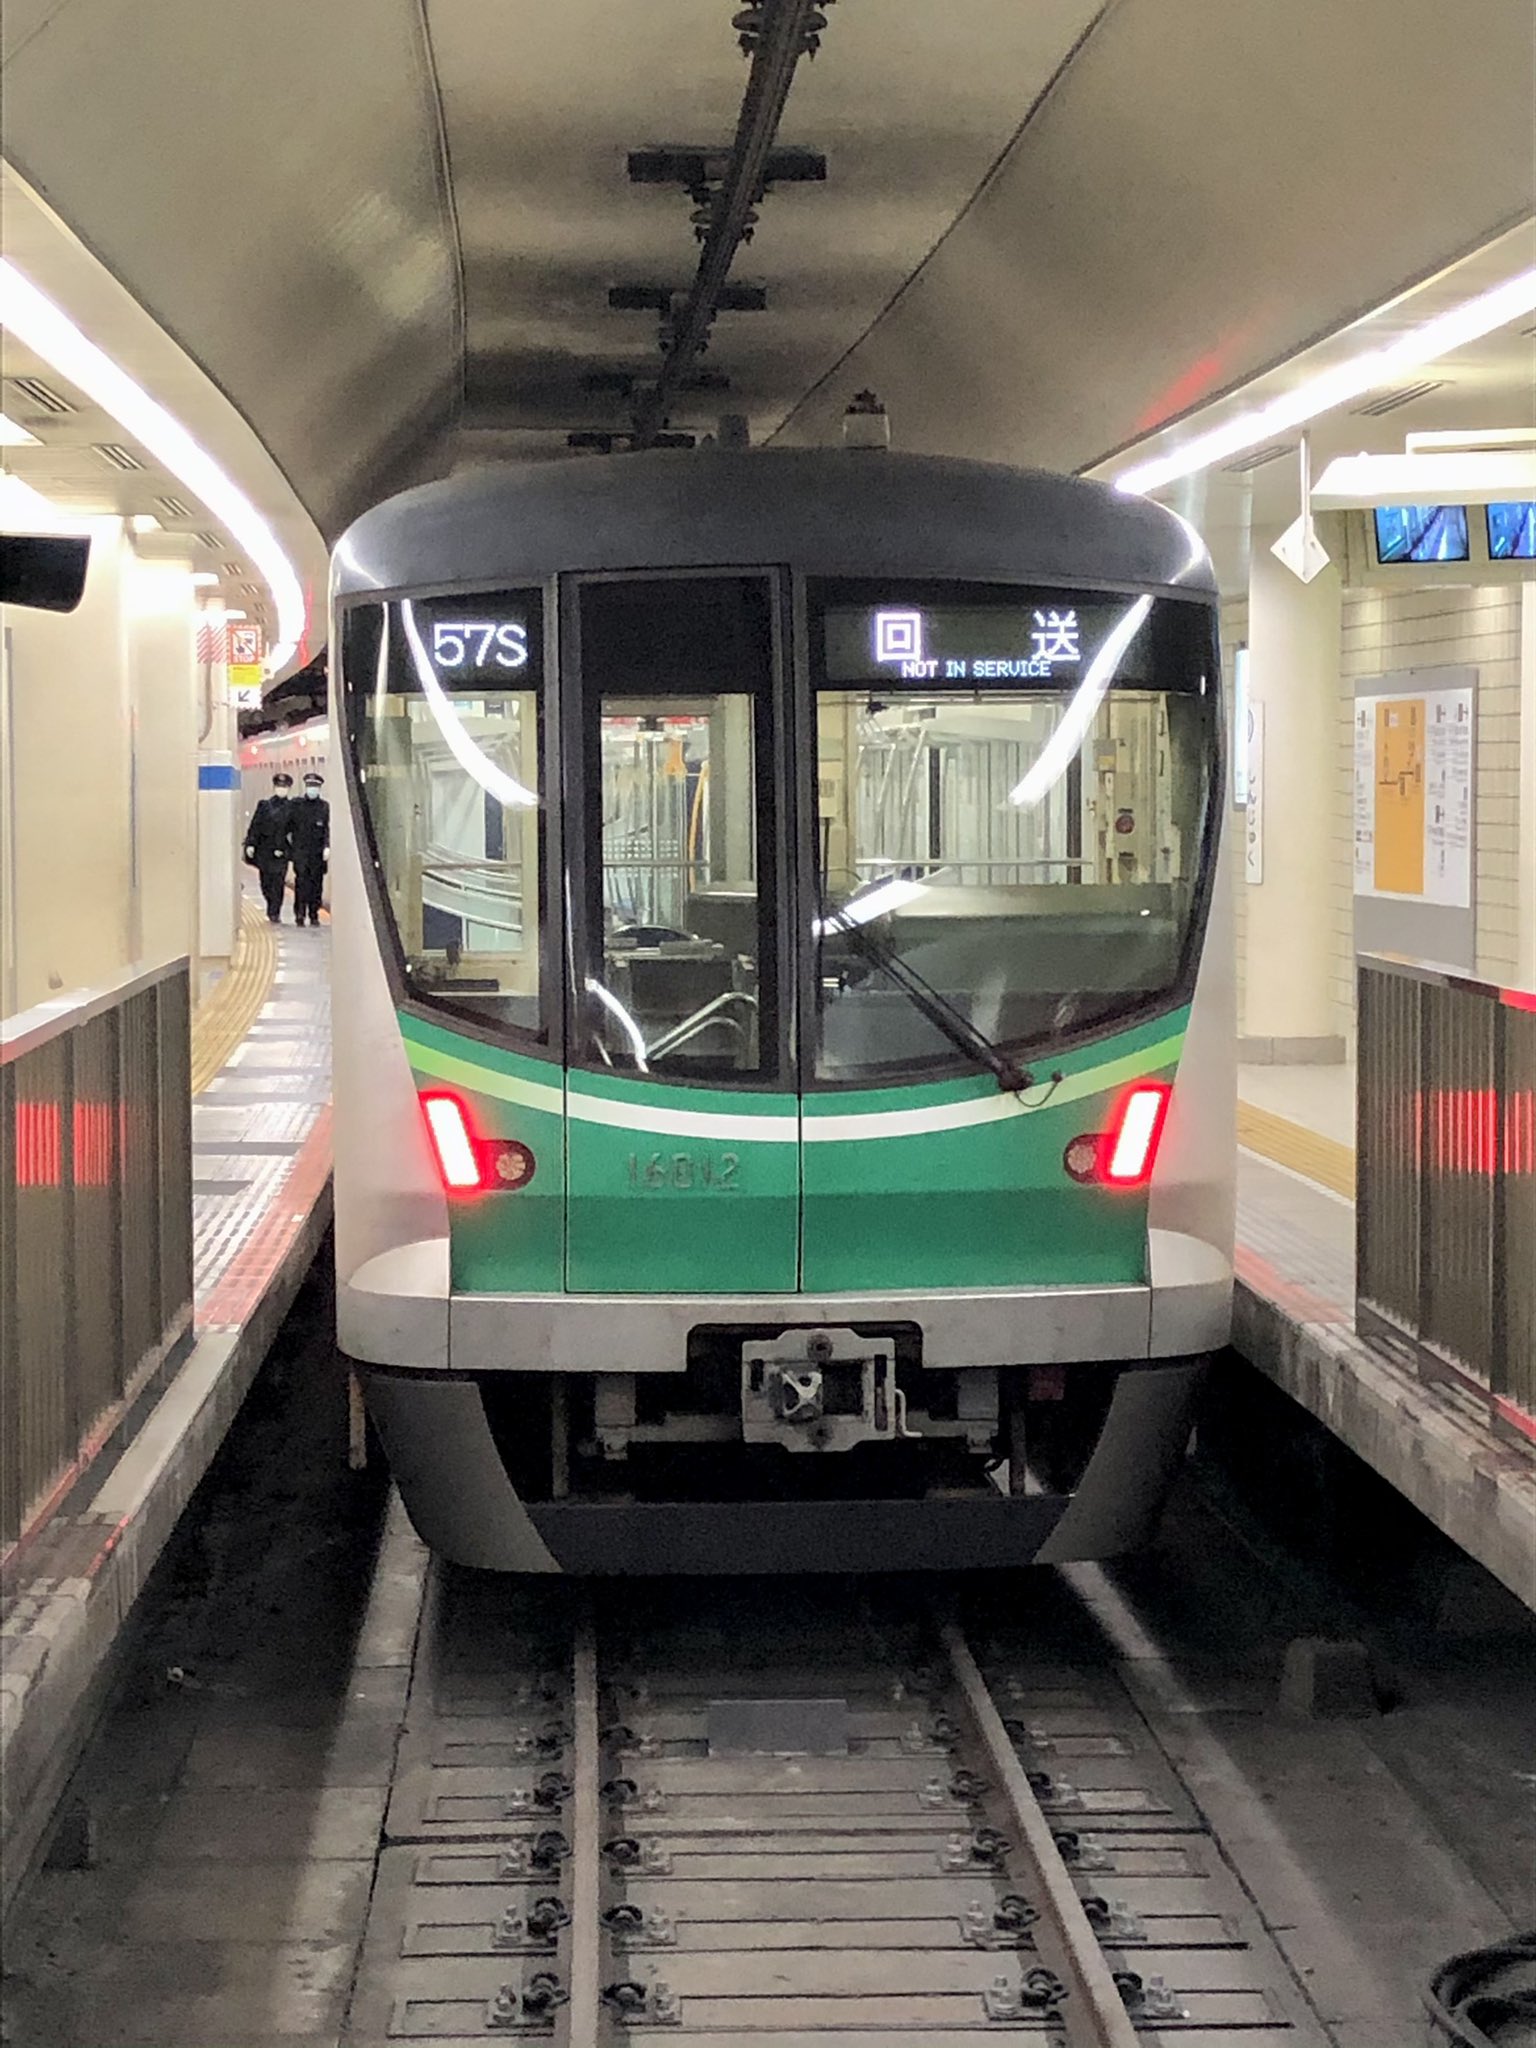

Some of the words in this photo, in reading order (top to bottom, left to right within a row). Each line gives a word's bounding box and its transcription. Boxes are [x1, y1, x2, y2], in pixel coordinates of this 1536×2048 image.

[433, 623, 528, 667] 57S
[902, 660, 939, 678] NOT
[945, 660, 966, 677] IN
[973, 660, 1052, 677] SERVICE
[628, 1152, 740, 1191] 16012
